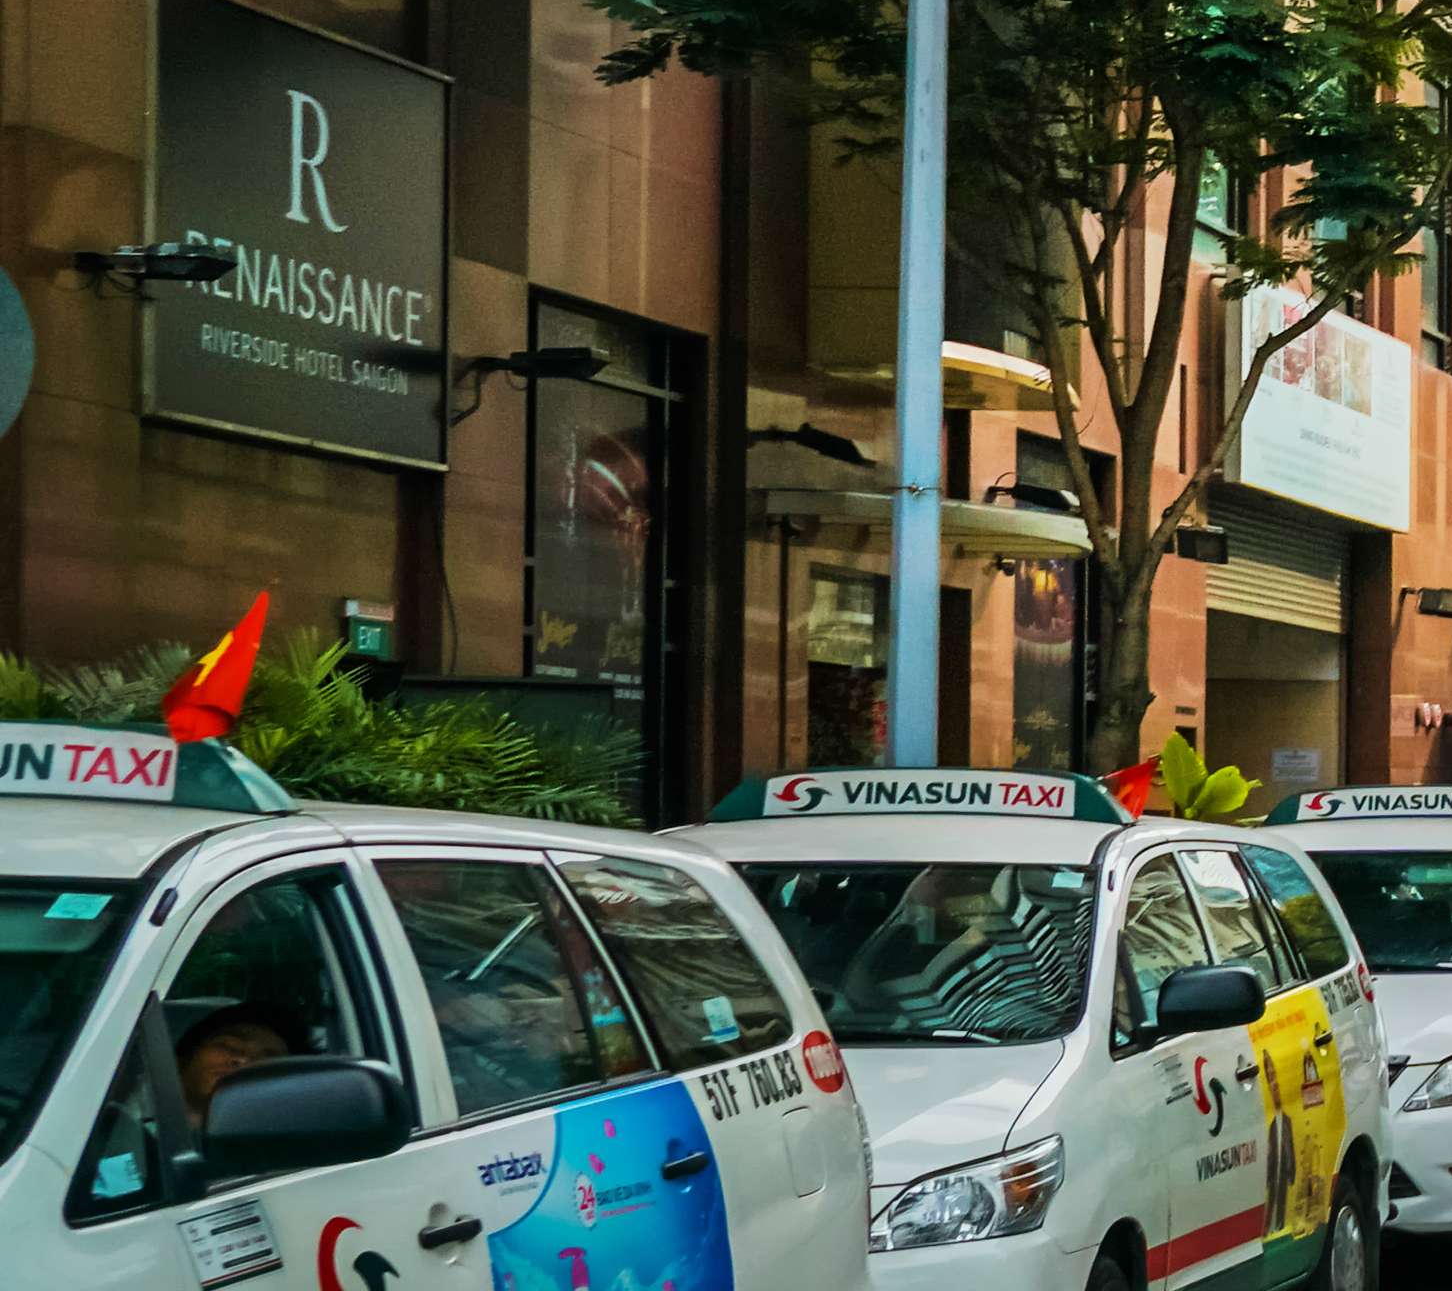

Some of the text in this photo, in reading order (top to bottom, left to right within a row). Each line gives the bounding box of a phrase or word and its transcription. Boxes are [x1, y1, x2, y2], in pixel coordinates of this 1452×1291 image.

[286, 89, 349, 233] R
[201, 323, 408, 396] RIVERSIDE HOTEL SAIGON
[62, 744, 173, 787] TAXI
[842, 780, 1066, 808] VINASUN TAXI
